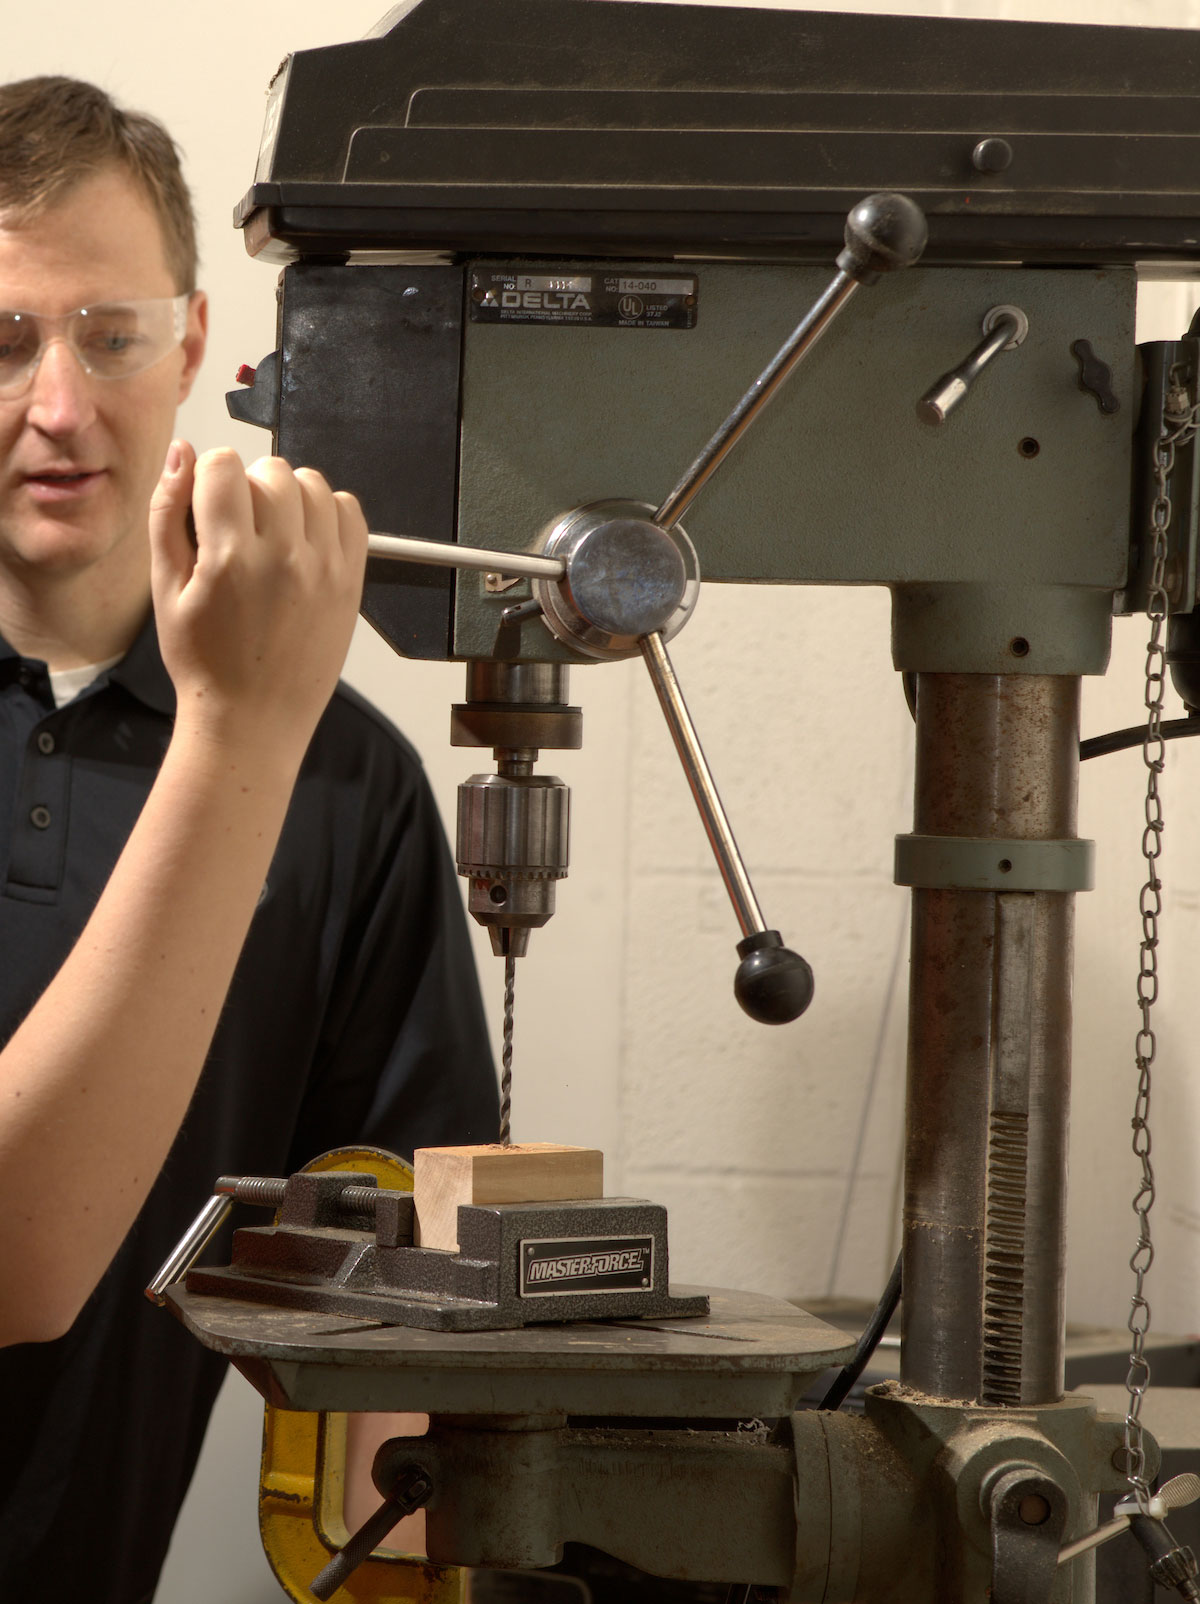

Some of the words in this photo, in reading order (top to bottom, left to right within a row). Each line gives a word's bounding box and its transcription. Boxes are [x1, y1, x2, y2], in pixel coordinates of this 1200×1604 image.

[622, 281, 657, 290] 14-040
[502, 292, 590, 309] DELTA
[622, 297, 639, 316] UL
